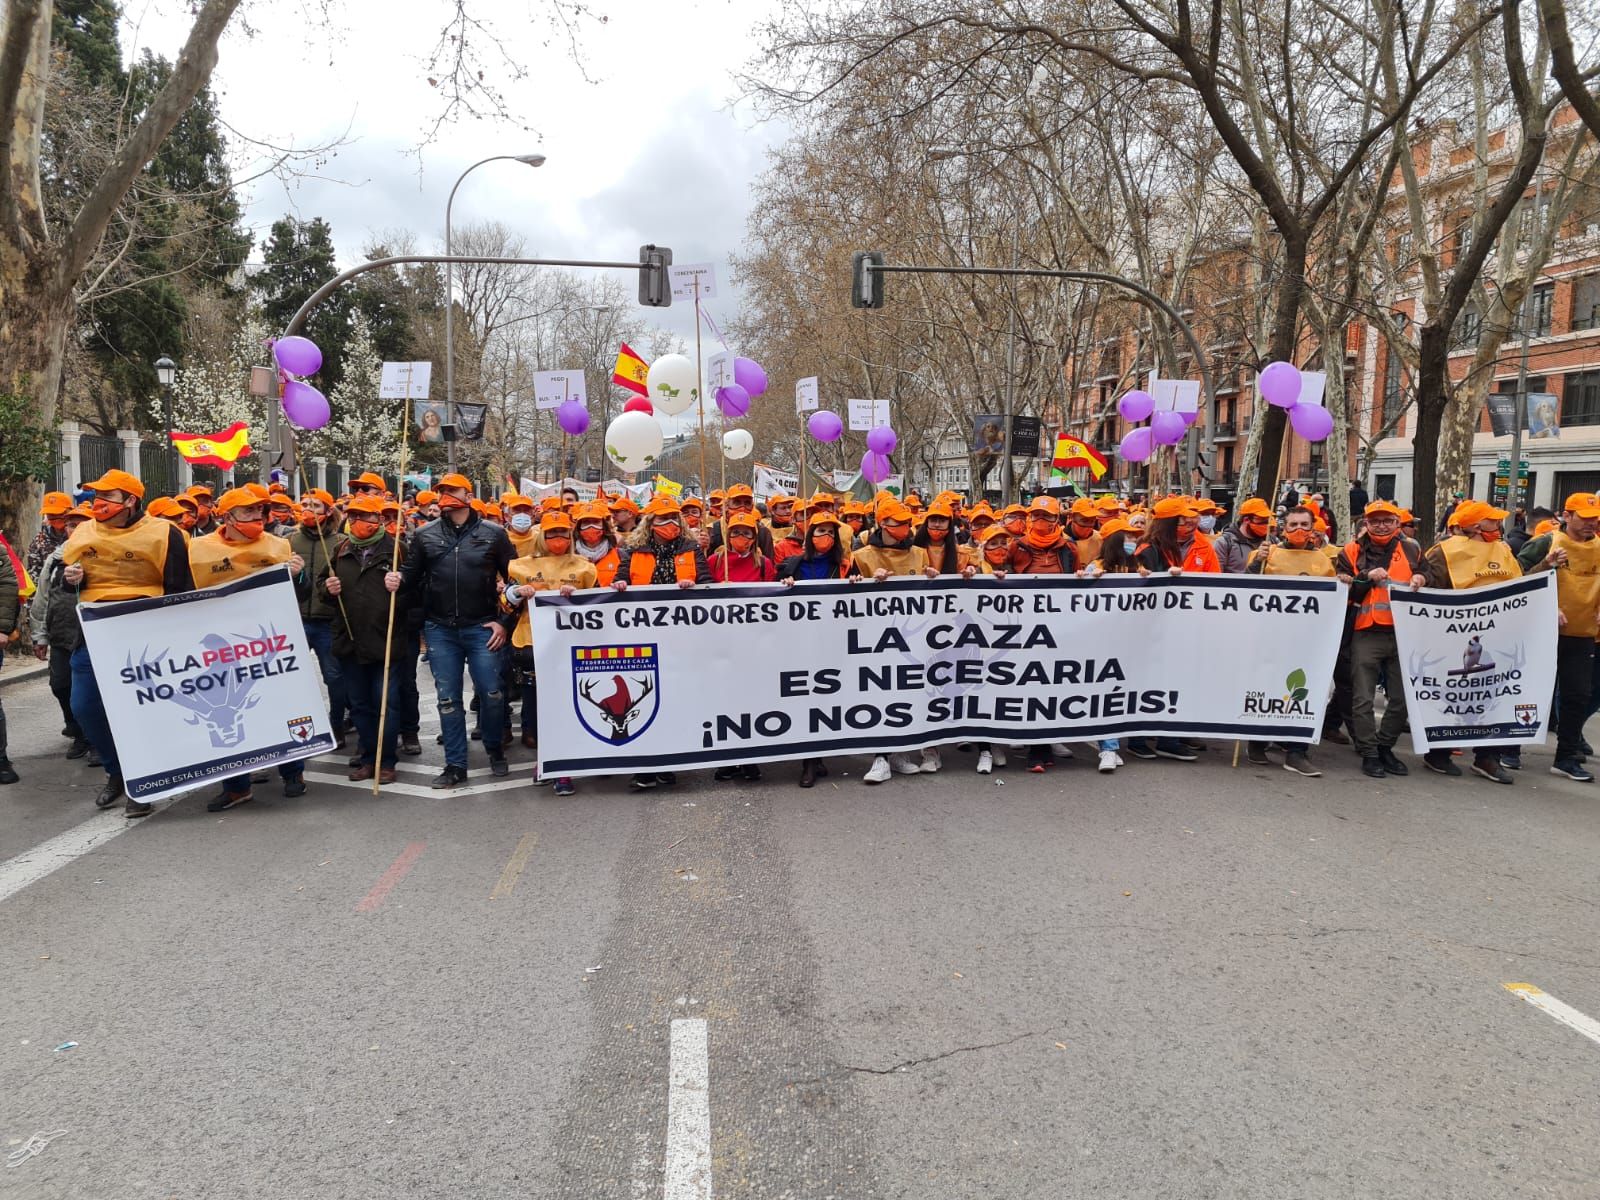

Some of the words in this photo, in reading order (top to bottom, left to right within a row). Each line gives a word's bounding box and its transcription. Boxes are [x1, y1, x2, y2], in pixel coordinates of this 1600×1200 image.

[555, 610, 604, 630] LOS
[615, 603, 779, 629] CAZADORES
[789, 601, 822, 621] DE
[977, 594, 1025, 614] POR
[1033, 594, 1062, 613] EL
[1071, 592, 1156, 613] FUTURO
[1164, 591, 1194, 611] DE
[1204, 592, 1238, 612] LA
[1249, 594, 1320, 614] CAZA
[1408, 606, 1430, 618] LA
[1434, 604, 1500, 620] JUSTICIA
[1503, 596, 1528, 612] NOS
[848, 627, 911, 655] LA
[926, 623, 1058, 650] CAZA
[1446, 620, 1496, 634] AVALA
[120, 662, 163, 684] SIN
[168, 655, 201, 675] LA
[202, 634, 294, 667] PERDIZ,
[136, 684, 174, 706] NO
[181, 670, 228, 696] SOY
[236, 655, 300, 684] FELIZ
[780, 668, 842, 698] ES
[858, 658, 1126, 692] NECESARIA
[1410, 676, 1418, 688] Y
[1422, 676, 1442, 688] EL
[1446, 669, 1522, 688] GOBIERNO
[1245, 690, 1266, 699] 20M
[1445, 692, 1492, 703] QUITA
[1495, 684, 1522, 698] LAS
[702, 710, 792, 748] ¡NO
[809, 702, 914, 733] NOS
[926, 686, 1179, 722] SILENCIÉIS!
[1244, 698, 1314, 716] RURAL
[1443, 704, 1485, 715] ALAS
[1442, 727, 1500, 738] SILVESTRISMO
[135, 776, 172, 793] ¿DÓNDE
[172, 770, 194, 784] ESTÁ
[194, 768, 206, 779] EL
[206, 760, 243, 776] SENTIDO
[244, 750, 280, 767] COMÚN?
